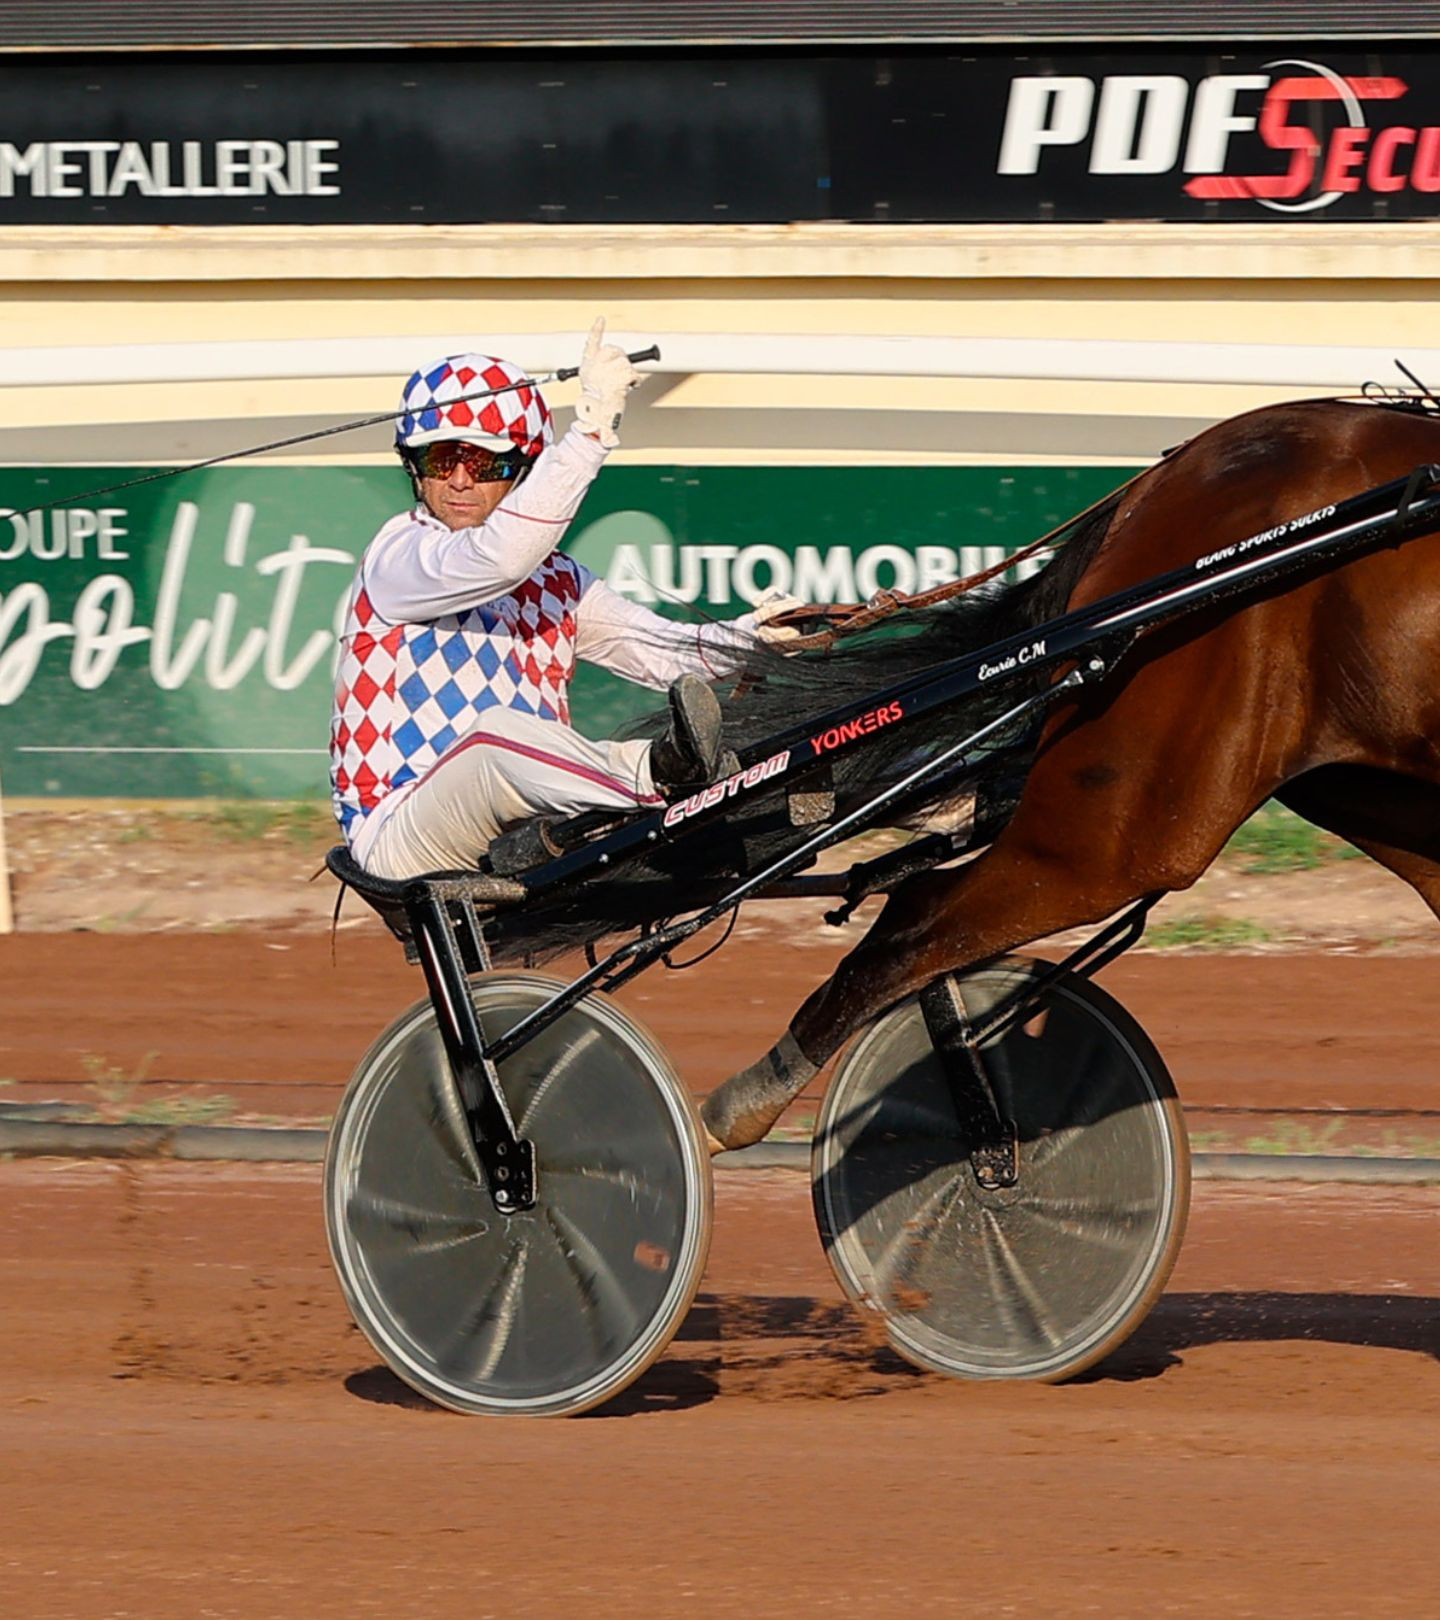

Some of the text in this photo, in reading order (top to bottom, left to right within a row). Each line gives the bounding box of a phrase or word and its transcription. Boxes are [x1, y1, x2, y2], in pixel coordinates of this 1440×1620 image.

[997, 74, 1270, 174] PDF
[0, 140, 340, 197] METALLERIE
[978, 656, 1017, 681] Ecurie
[810, 700, 904, 756] YONKERS
[663, 749, 792, 828] CUSTOM
